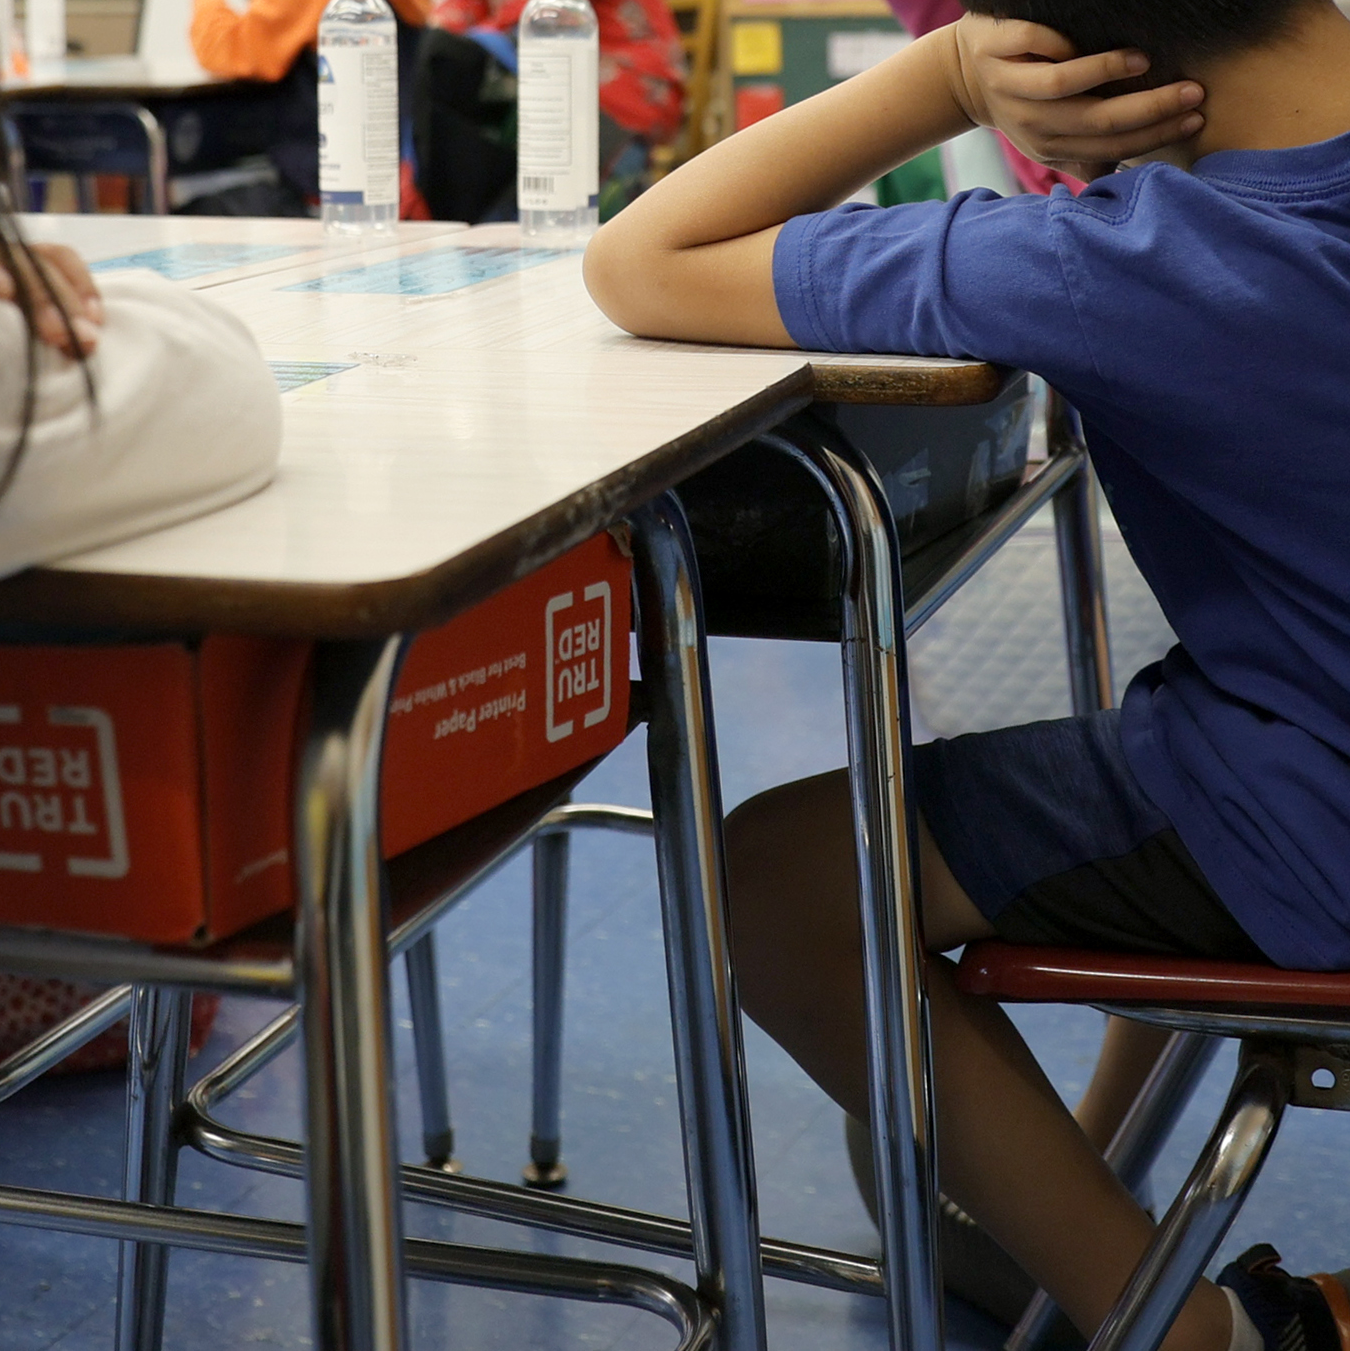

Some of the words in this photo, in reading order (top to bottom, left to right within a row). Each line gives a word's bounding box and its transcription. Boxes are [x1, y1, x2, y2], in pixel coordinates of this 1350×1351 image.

[558, 618, 600, 662] RED
[457, 666, 488, 692] Black
[488, 661, 503, 677] for
[504, 652, 527, 673] Best
[415, 682, 448, 704] White
[558, 657, 600, 703] TRU
[433, 704, 477, 740] Paper
[478, 688, 527, 722] Printer
[0, 791, 98, 836] TRU
